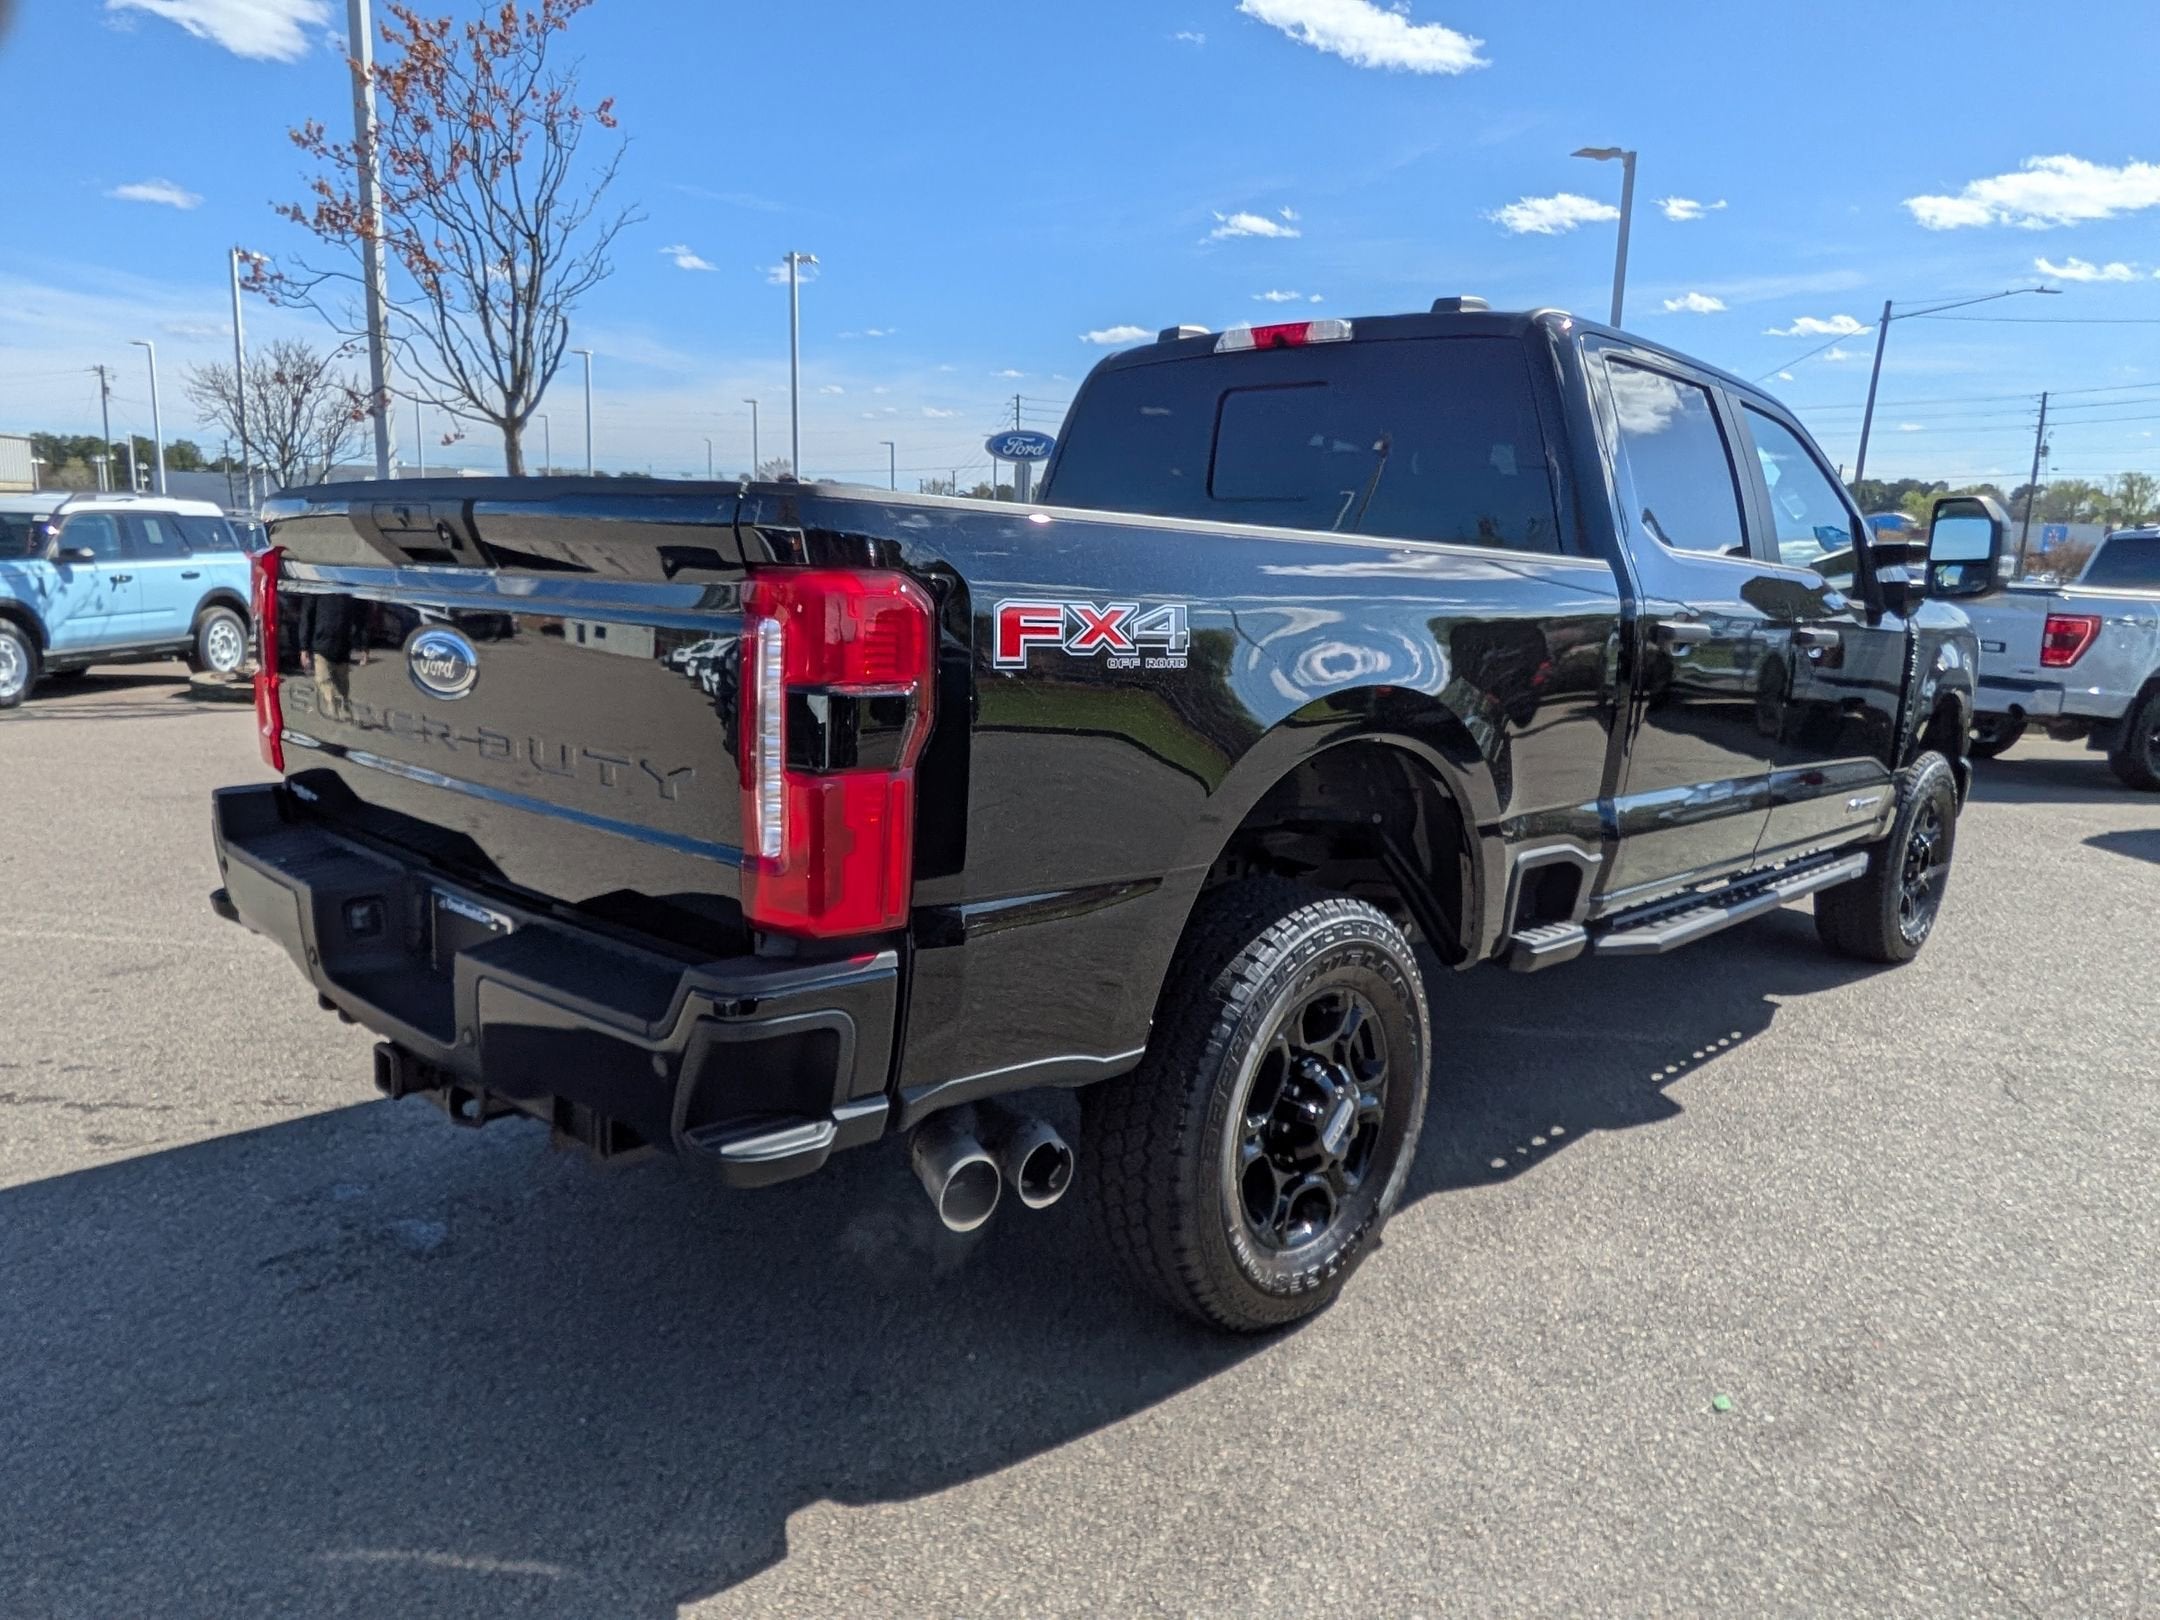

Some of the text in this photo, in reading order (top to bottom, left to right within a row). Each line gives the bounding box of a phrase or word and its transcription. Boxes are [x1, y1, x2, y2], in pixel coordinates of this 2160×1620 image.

[1002, 436, 1046, 455] Ford
[993, 598, 1190, 669] FX4
[420, 642, 456, 679] Ford
[1107, 657, 1188, 669] OFF ROAD
